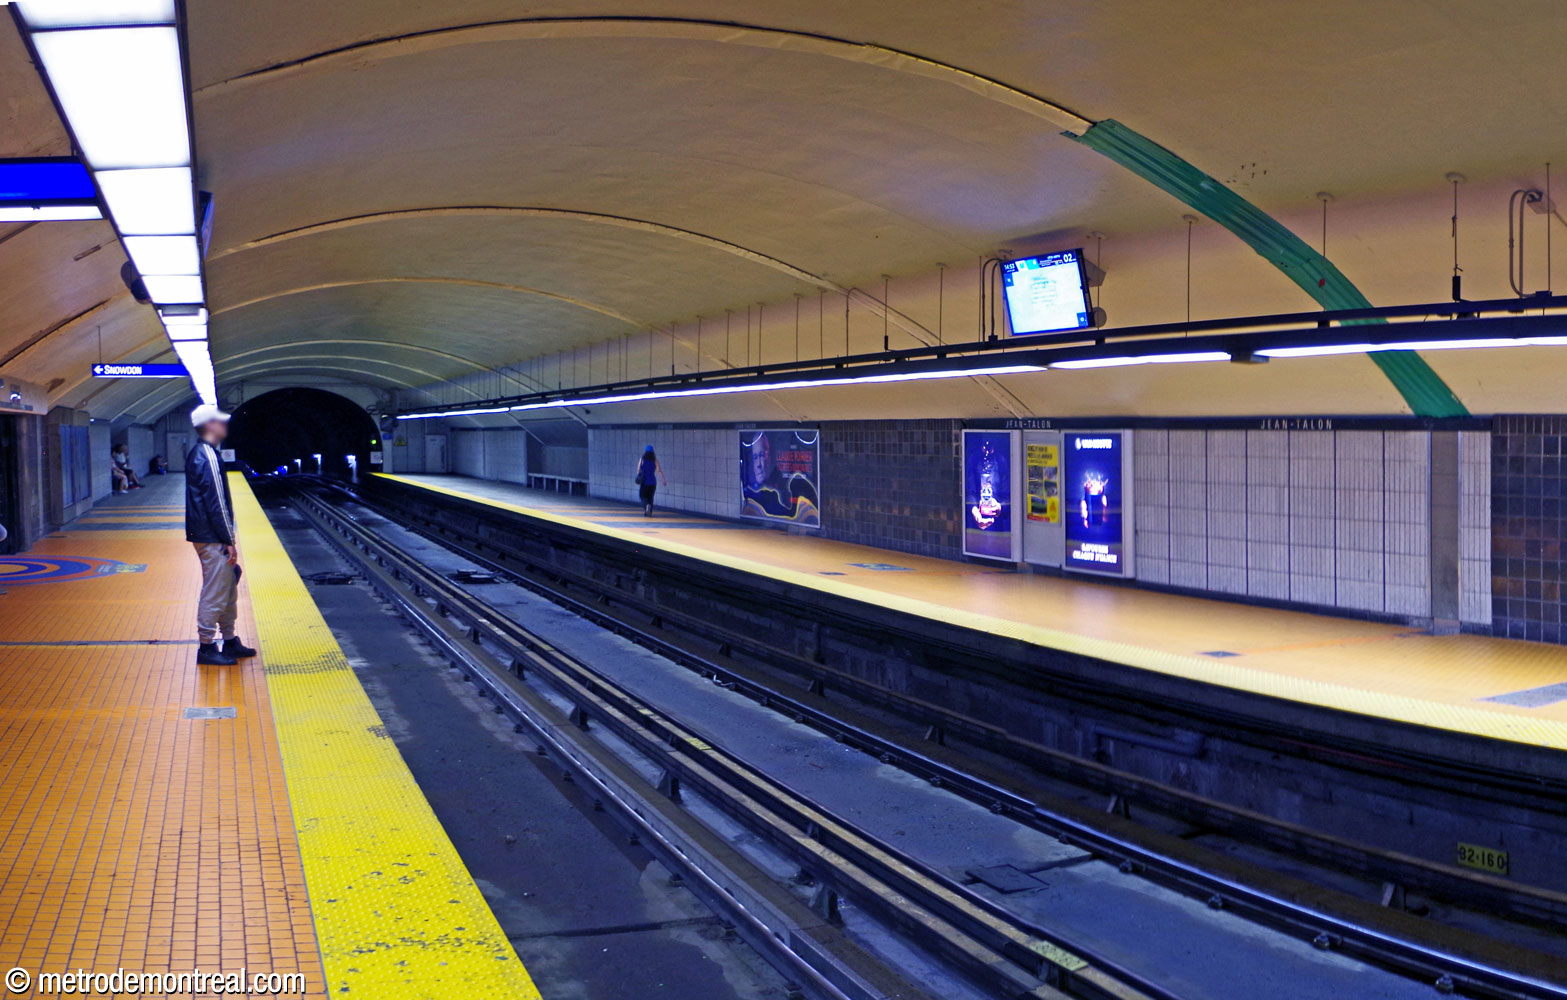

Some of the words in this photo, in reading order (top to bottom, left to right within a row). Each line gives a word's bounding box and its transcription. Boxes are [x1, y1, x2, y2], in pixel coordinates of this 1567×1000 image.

[104, 365, 142, 375] SNOWDON
[1005, 419, 1051, 429] JEAN-TALON
[1260, 418, 1332, 430] JEAN-TALON
